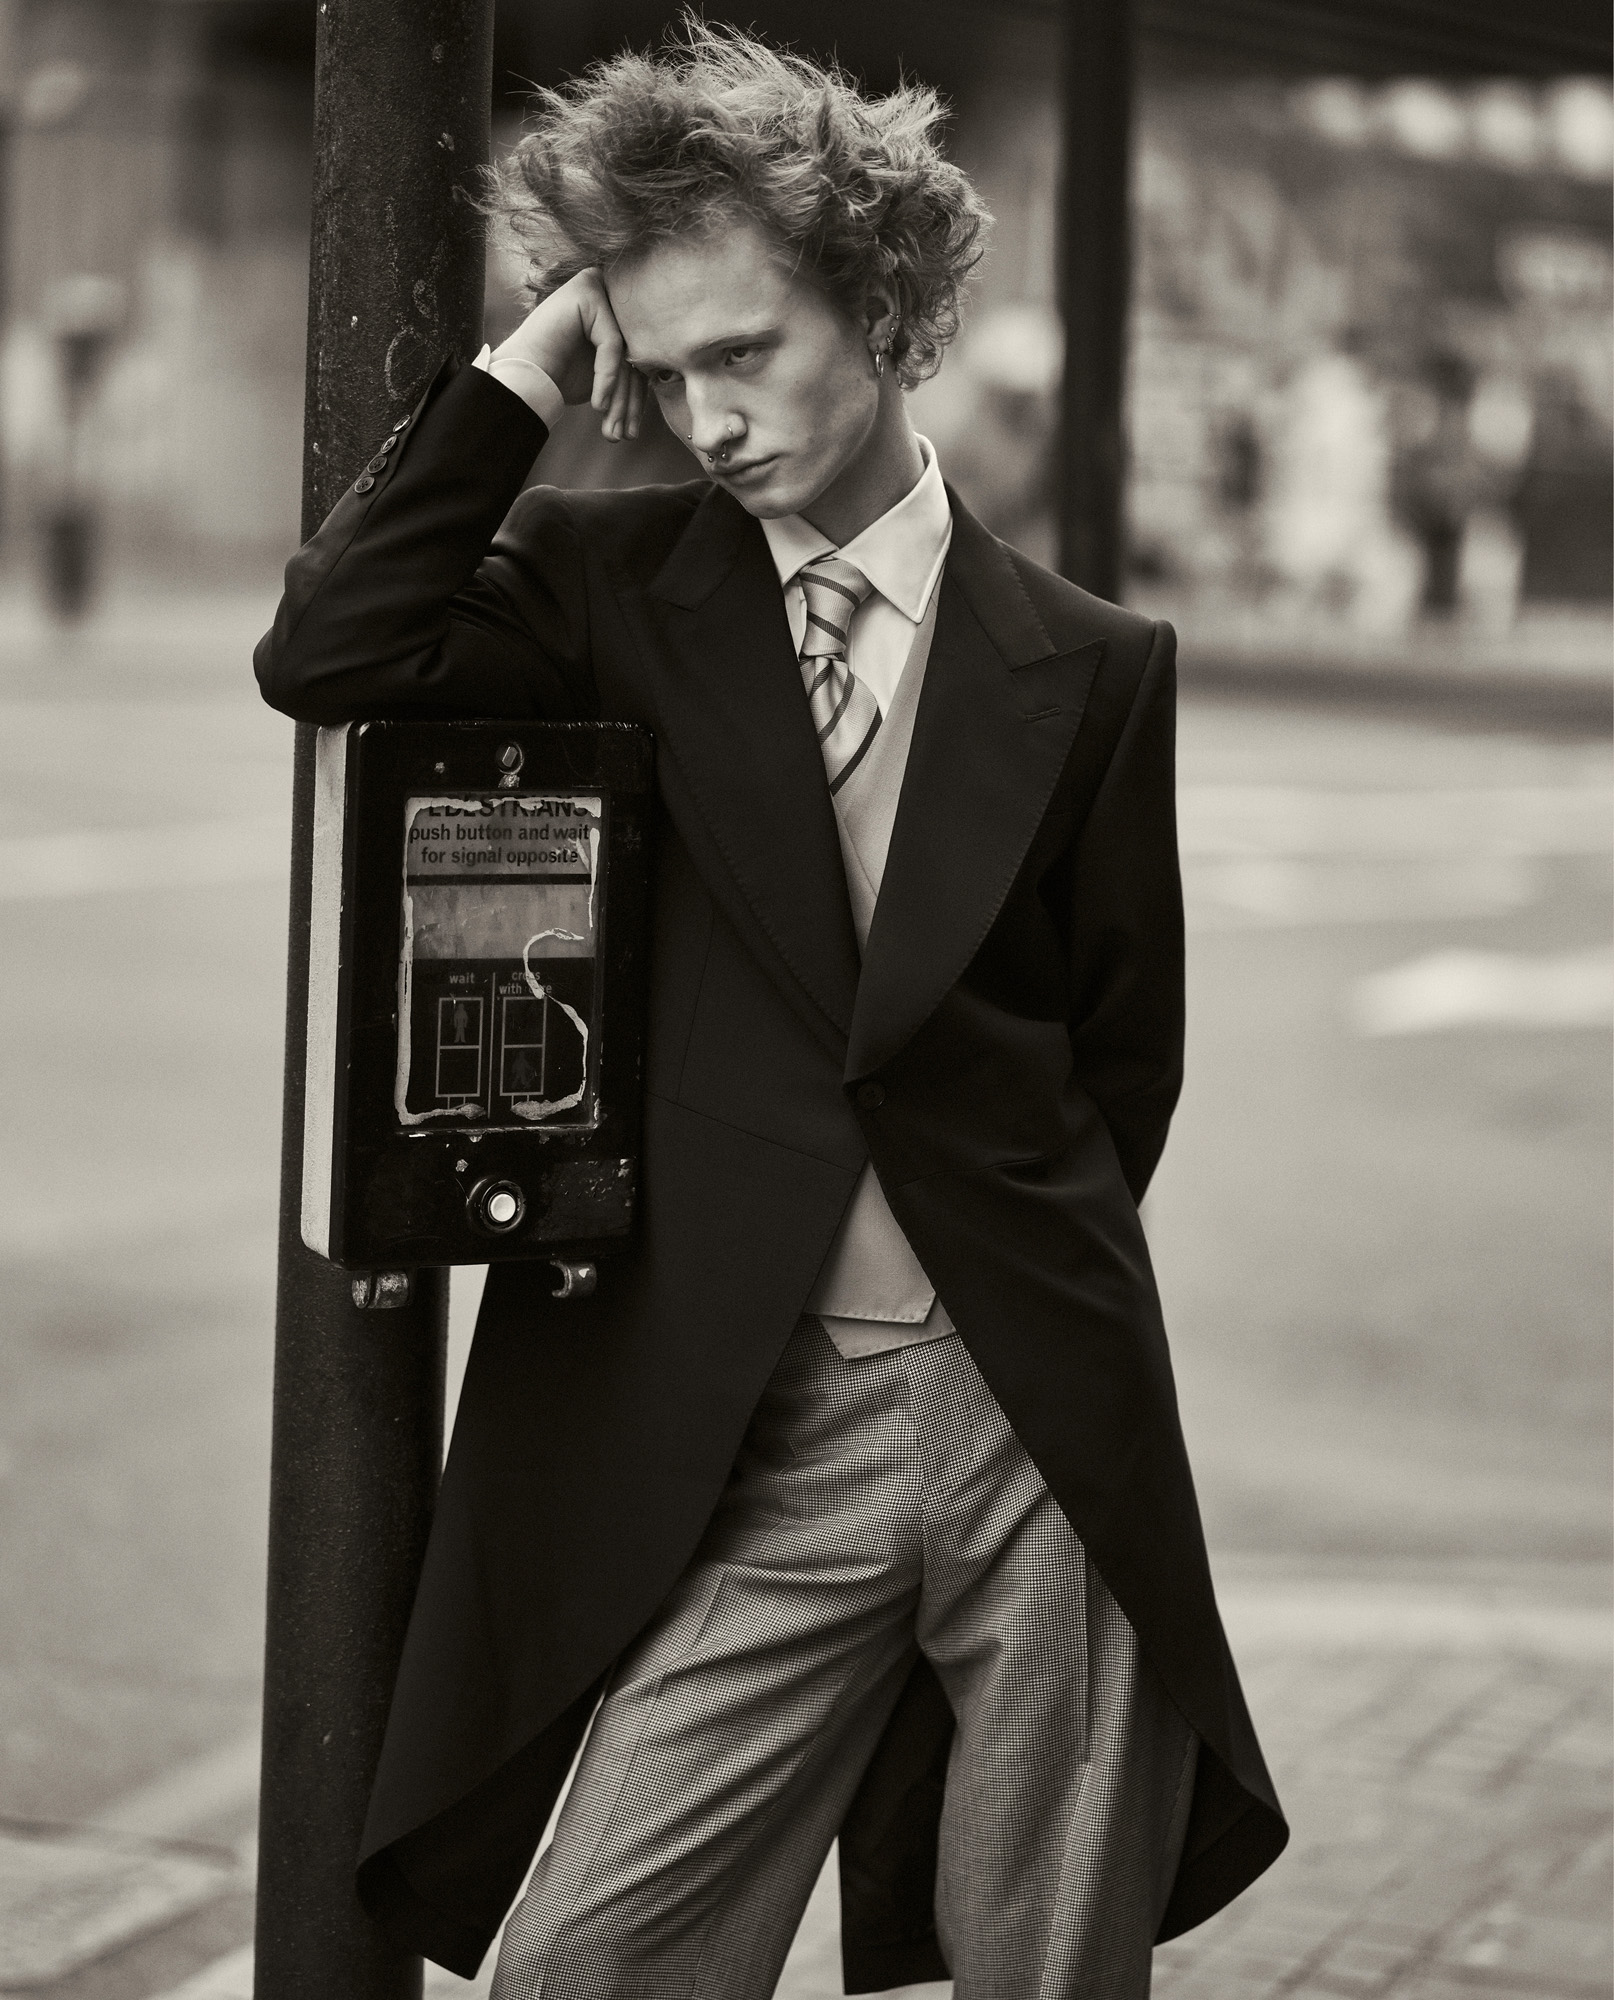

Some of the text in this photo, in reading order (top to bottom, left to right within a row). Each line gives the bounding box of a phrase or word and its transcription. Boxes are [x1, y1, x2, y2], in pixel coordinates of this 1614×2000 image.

[428, 796, 589, 817] EDESTRIANS
[410, 823, 589, 844] push button and wait
[421, 846, 578, 867] for signal opposite
[449, 972, 475, 984] wait
[511, 971, 541, 981] crs
[499, 982, 522, 995] with
